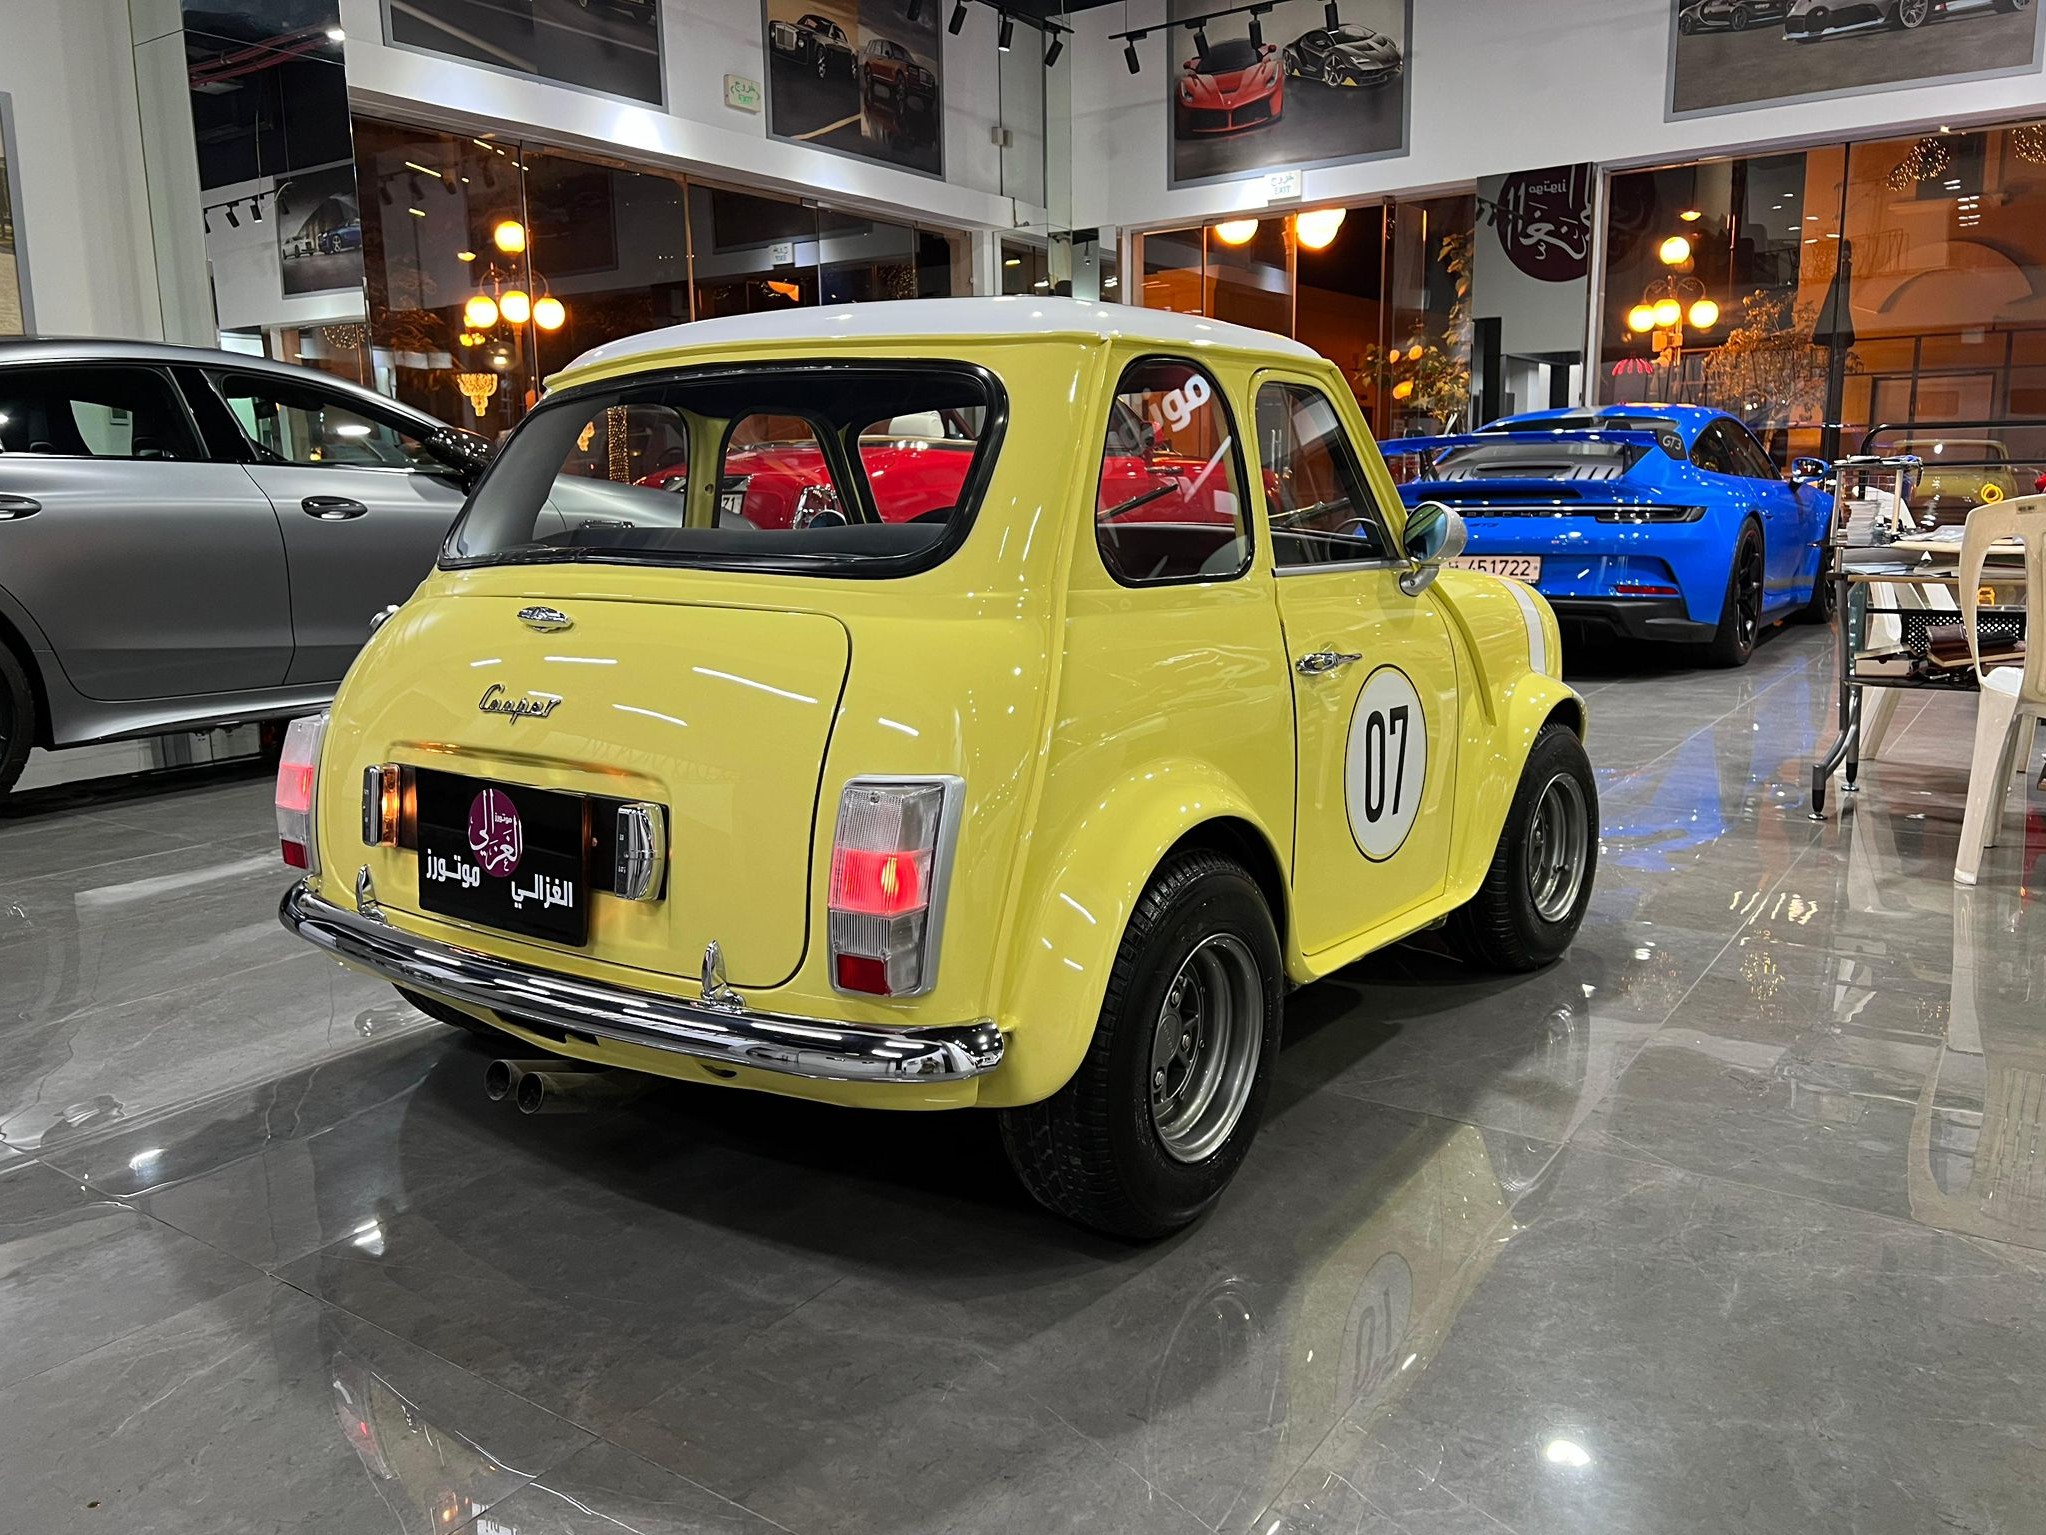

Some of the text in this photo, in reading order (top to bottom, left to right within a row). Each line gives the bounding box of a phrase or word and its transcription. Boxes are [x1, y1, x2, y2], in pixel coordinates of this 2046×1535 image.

[1662, 434, 1682, 450] GT3
[479, 683, 562, 726] Cooper
[1365, 704, 1409, 824] 07
[494, 811, 513, 825] موتورز
[426, 848, 573, 909] الغزالي موتورز
